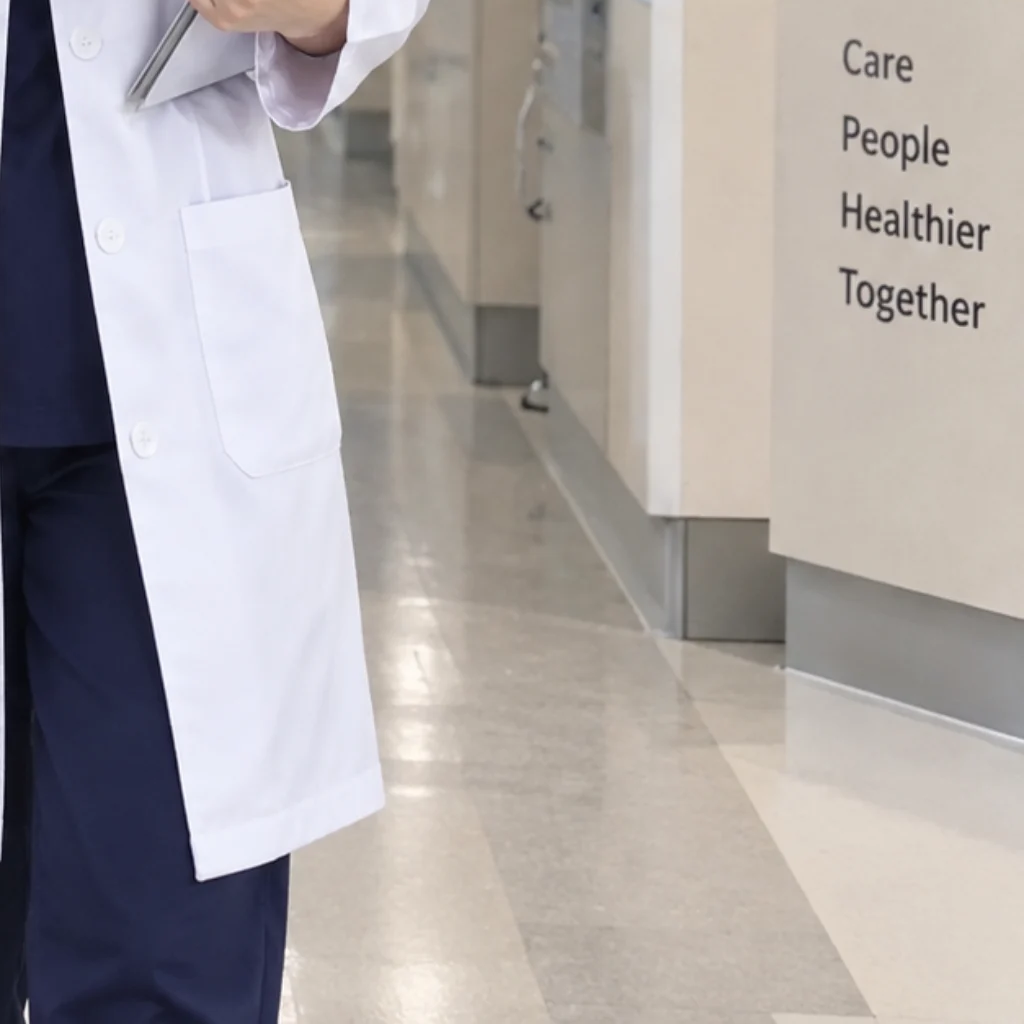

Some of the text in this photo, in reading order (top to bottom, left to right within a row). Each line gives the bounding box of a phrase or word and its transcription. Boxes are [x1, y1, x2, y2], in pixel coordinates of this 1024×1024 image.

[842, 38, 914, 83] Care
[842, 114, 950, 172] People
[841, 191, 991, 252] Healthier
[838, 267, 986, 329] Together
